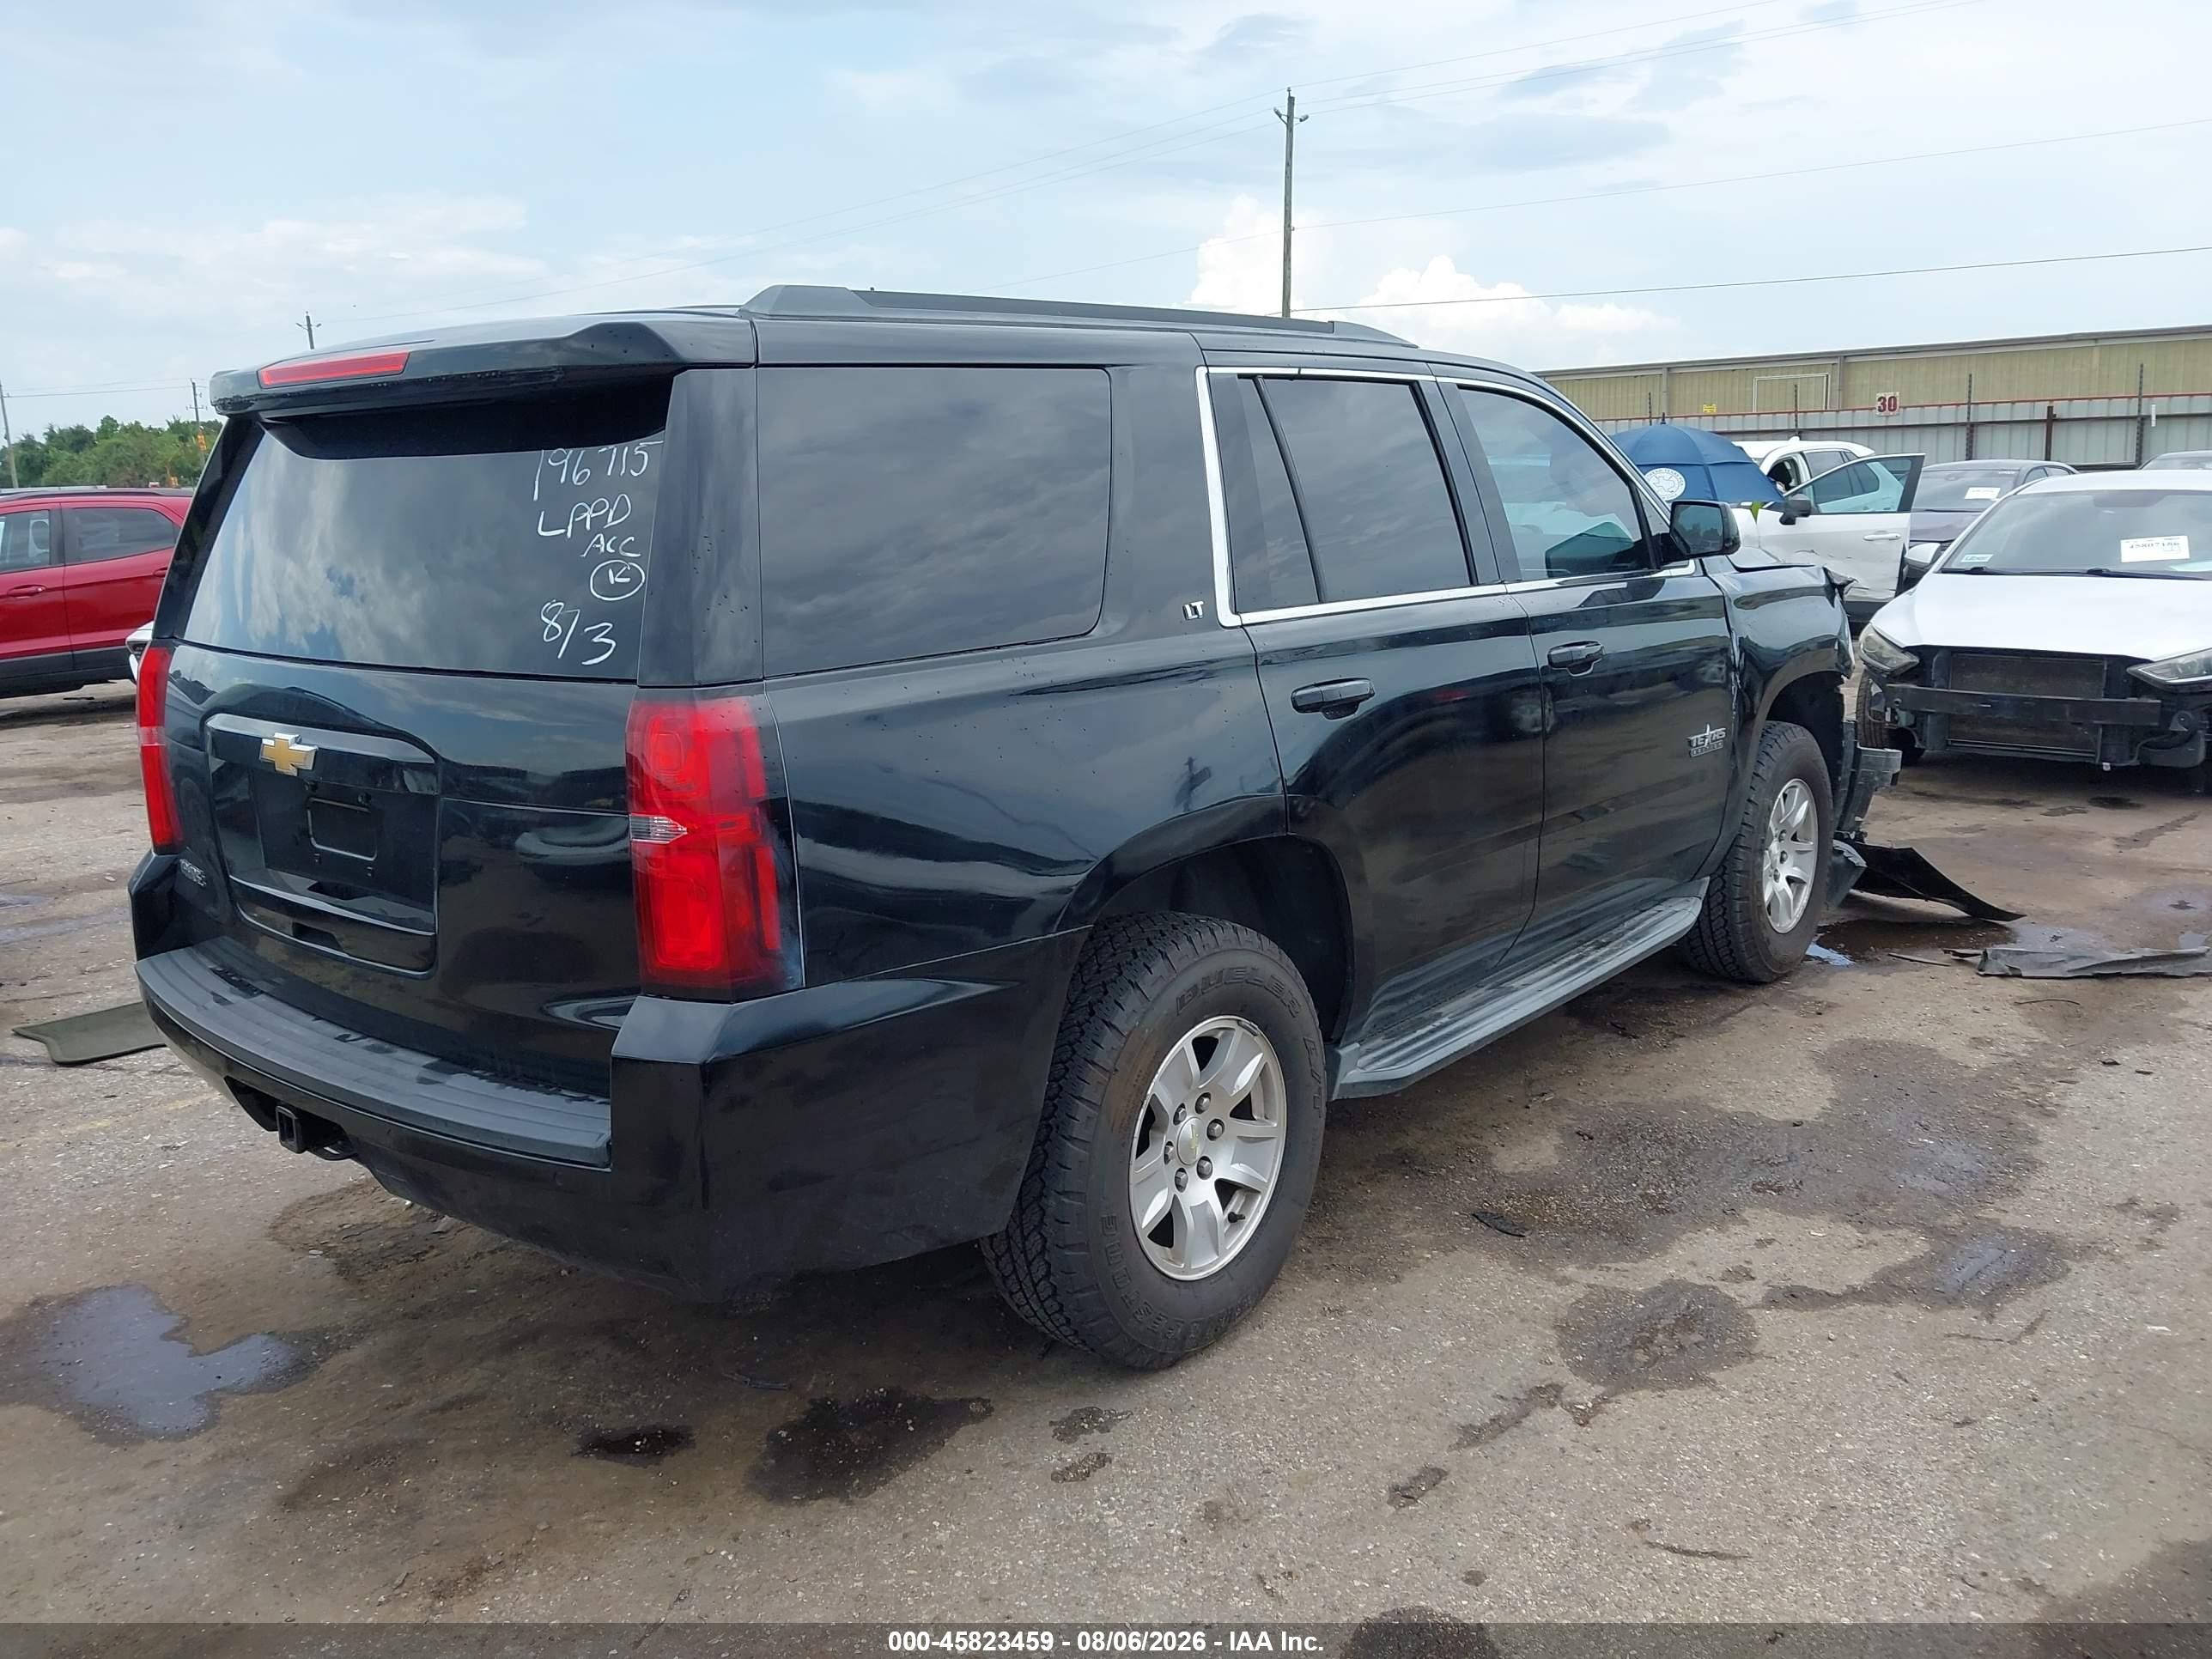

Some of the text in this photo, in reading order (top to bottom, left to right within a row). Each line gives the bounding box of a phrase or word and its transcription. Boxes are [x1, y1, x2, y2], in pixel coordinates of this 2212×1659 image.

[1877, 396, 1898, 412] 30
[580, 533, 641, 558] ACC
[1182, 601, 1204, 619] LT
[1176, 966, 1302, 1018] DUELER
